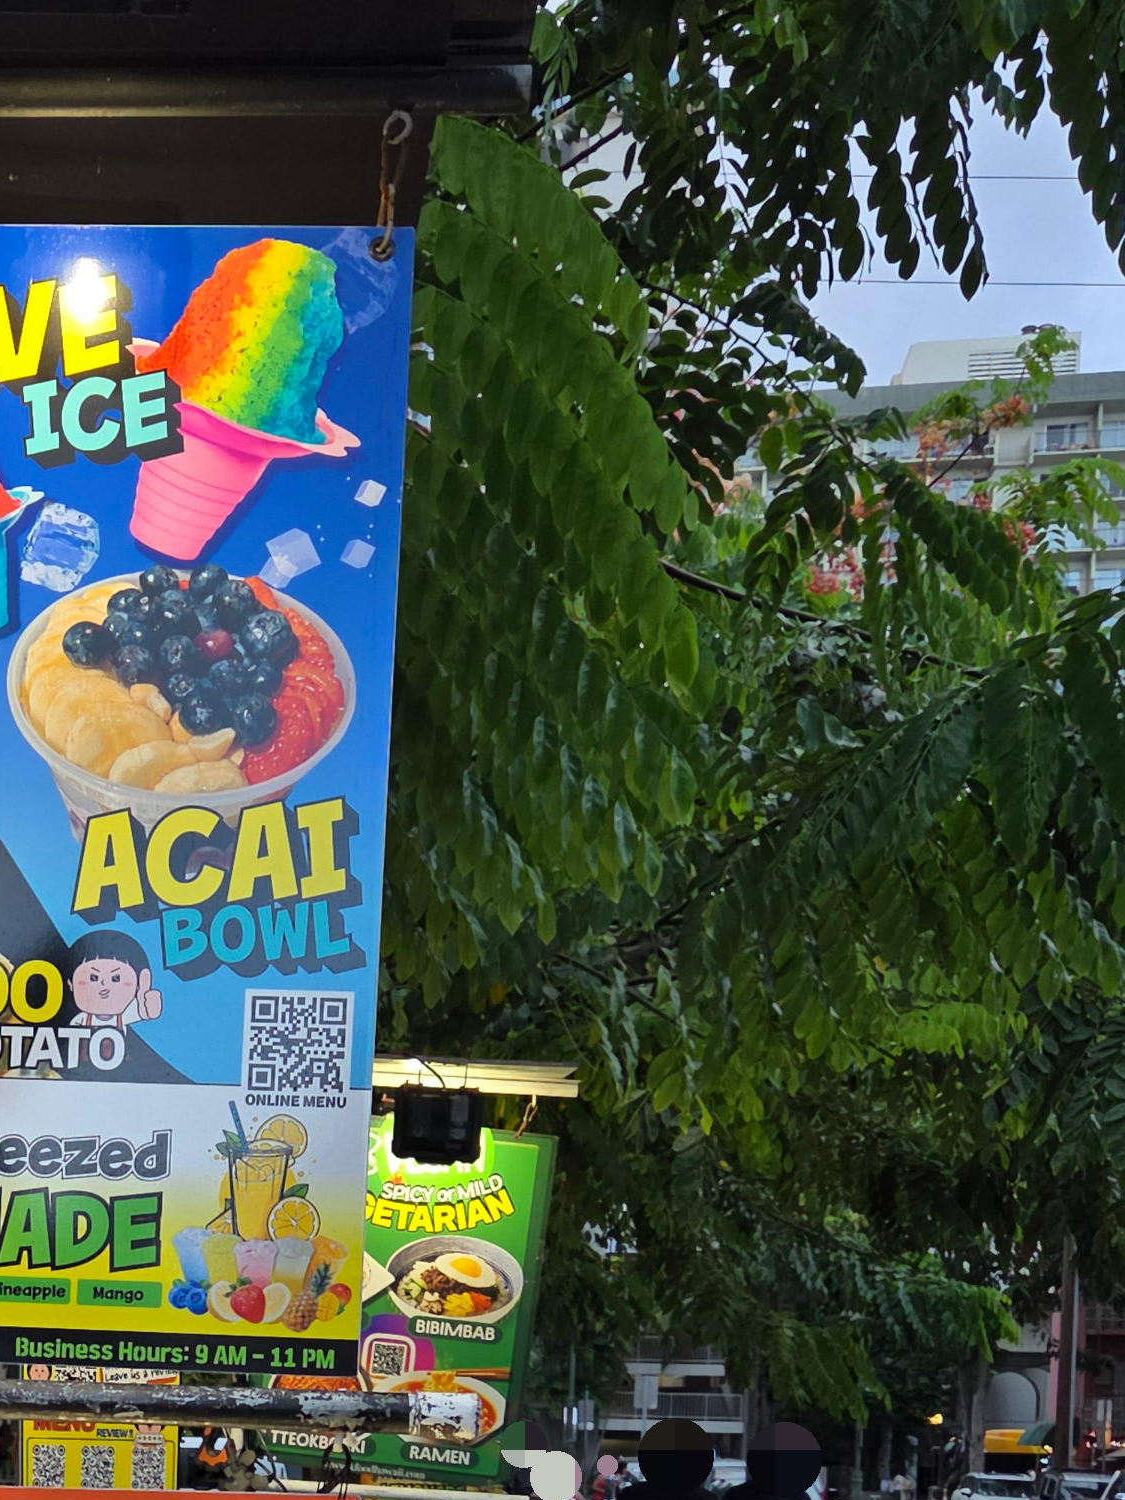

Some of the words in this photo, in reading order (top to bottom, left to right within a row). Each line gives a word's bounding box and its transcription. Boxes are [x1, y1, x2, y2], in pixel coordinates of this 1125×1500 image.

[23, 370, 171, 458] ICE
[73, 799, 349, 913] ACAI
[161, 900, 353, 970] BOWL
[244, 1094, 299, 1107] ONLINE
[302, 1095, 347, 1109] MENU
[380, 1182, 435, 1203] SPICY
[437, 1186, 455, 1203] or
[457, 1174, 504, 1200] MILD
[92, 1286, 145, 1303] Mango
[415, 1319, 496, 1341] BIBIMBAB
[14, 1337, 113, 1362] Business
[118, 1340, 190, 1366] Hours:
[194, 1344, 210, 1365] 9
[213, 1345, 248, 1367] AM
[269, 1347, 297, 1368] 11
[302, 1349, 336, 1370] PM
[105, 1372, 128, 1382] Leave
[143, 1369, 148, 1378] a
[96, 1428, 127, 1438] REVIEW
[271, 1429, 366, 1454] TTEOKBKI
[409, 1445, 471, 1466] RAMEN
